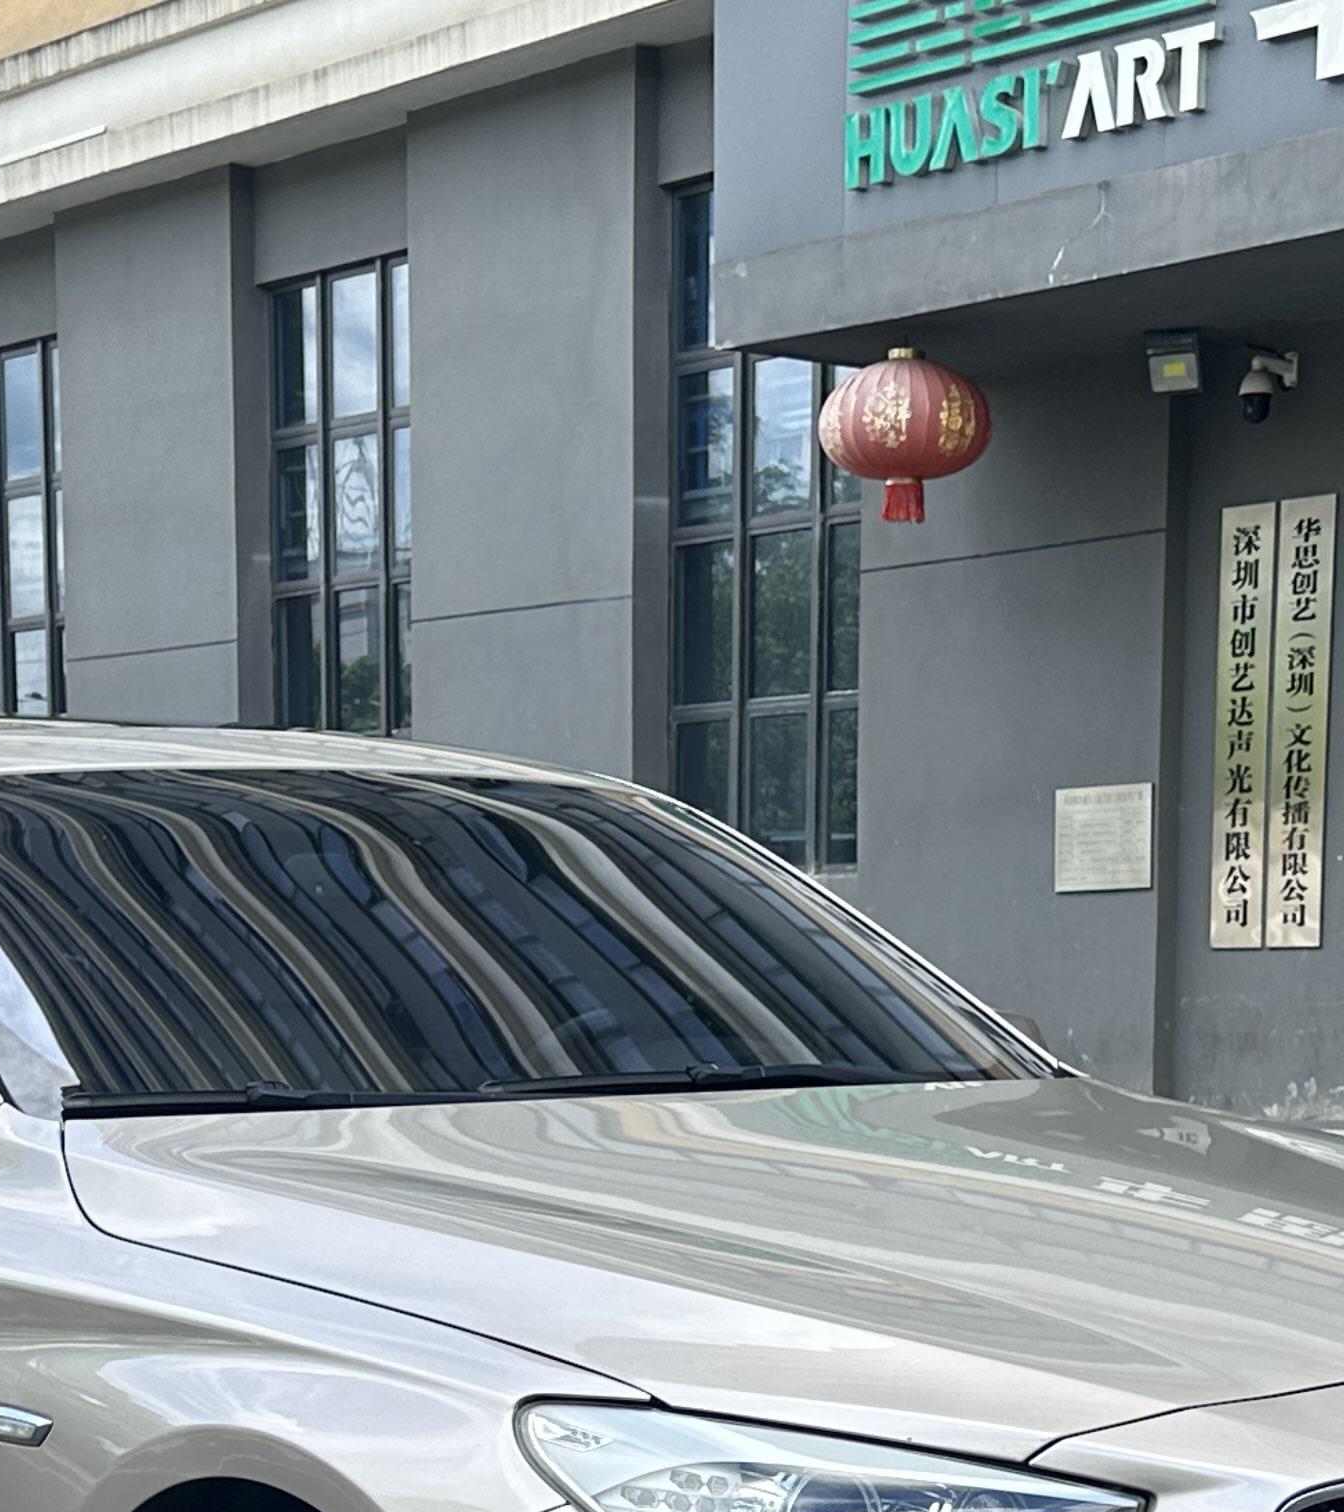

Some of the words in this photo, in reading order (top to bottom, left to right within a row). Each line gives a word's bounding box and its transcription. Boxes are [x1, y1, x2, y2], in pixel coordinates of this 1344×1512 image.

[1222, 524, 1262, 928] 深圳市创艺达声光有限公司
[1278, 515, 1323, 928] 华思创艺（深圳）文化传播有限公司
